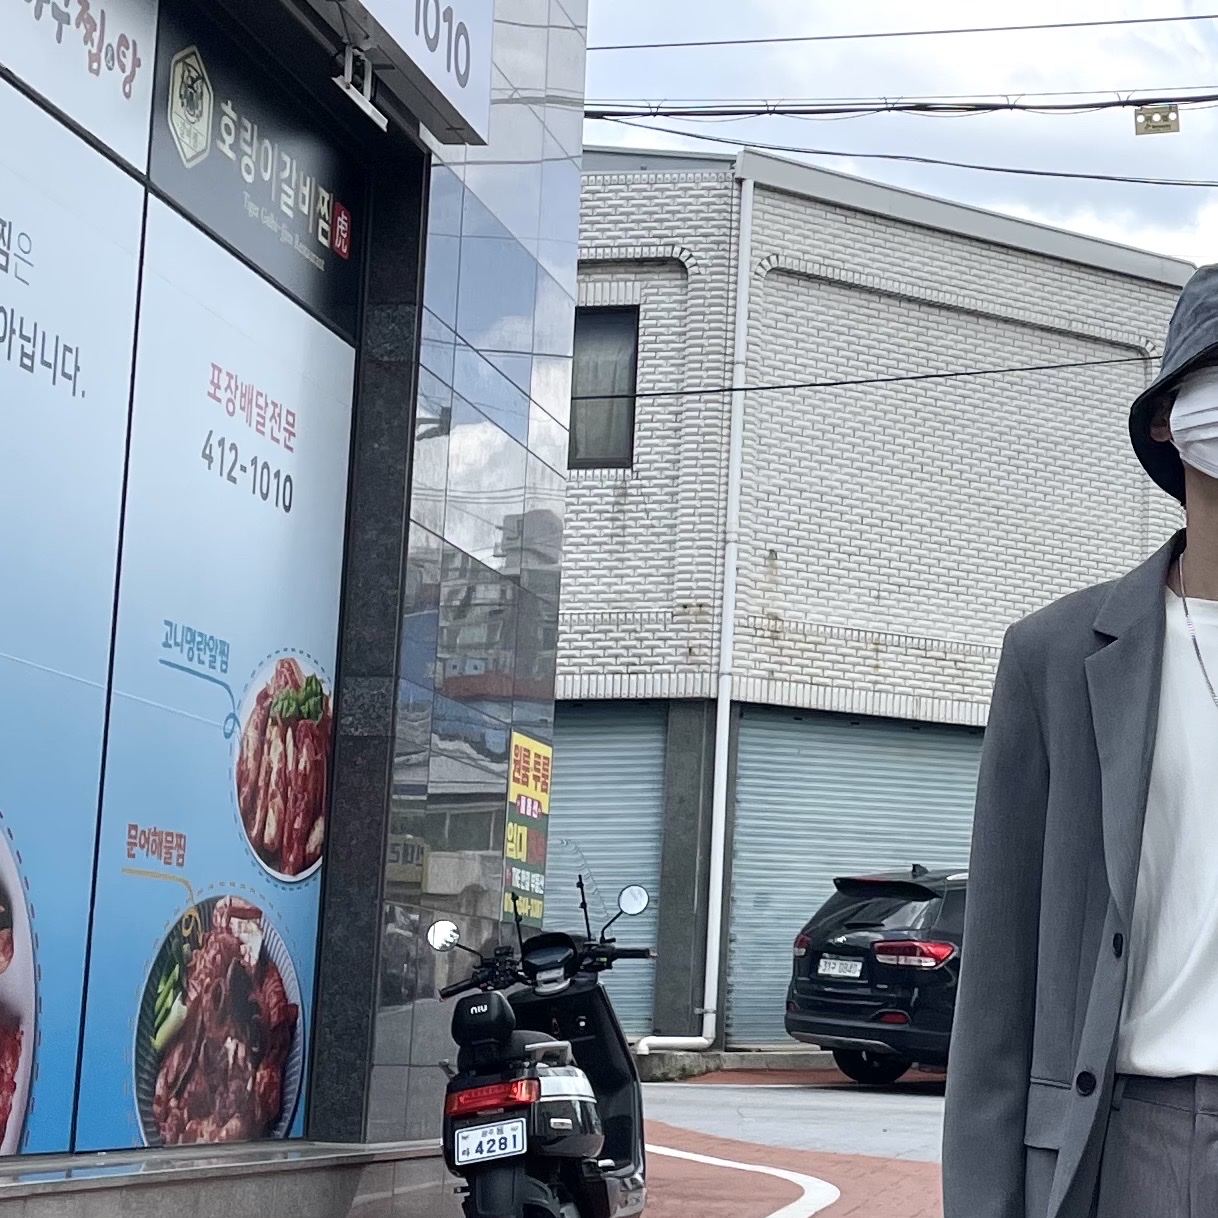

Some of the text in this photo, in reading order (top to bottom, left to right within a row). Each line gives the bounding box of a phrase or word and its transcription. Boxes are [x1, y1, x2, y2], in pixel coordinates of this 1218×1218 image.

[216, 100, 333, 249] 호랑이갈비찜
[207, 362, 297, 454] 포장배달전문
[201, 429, 294, 514] 412-1010
[475, 1134, 518, 1155] 4281
